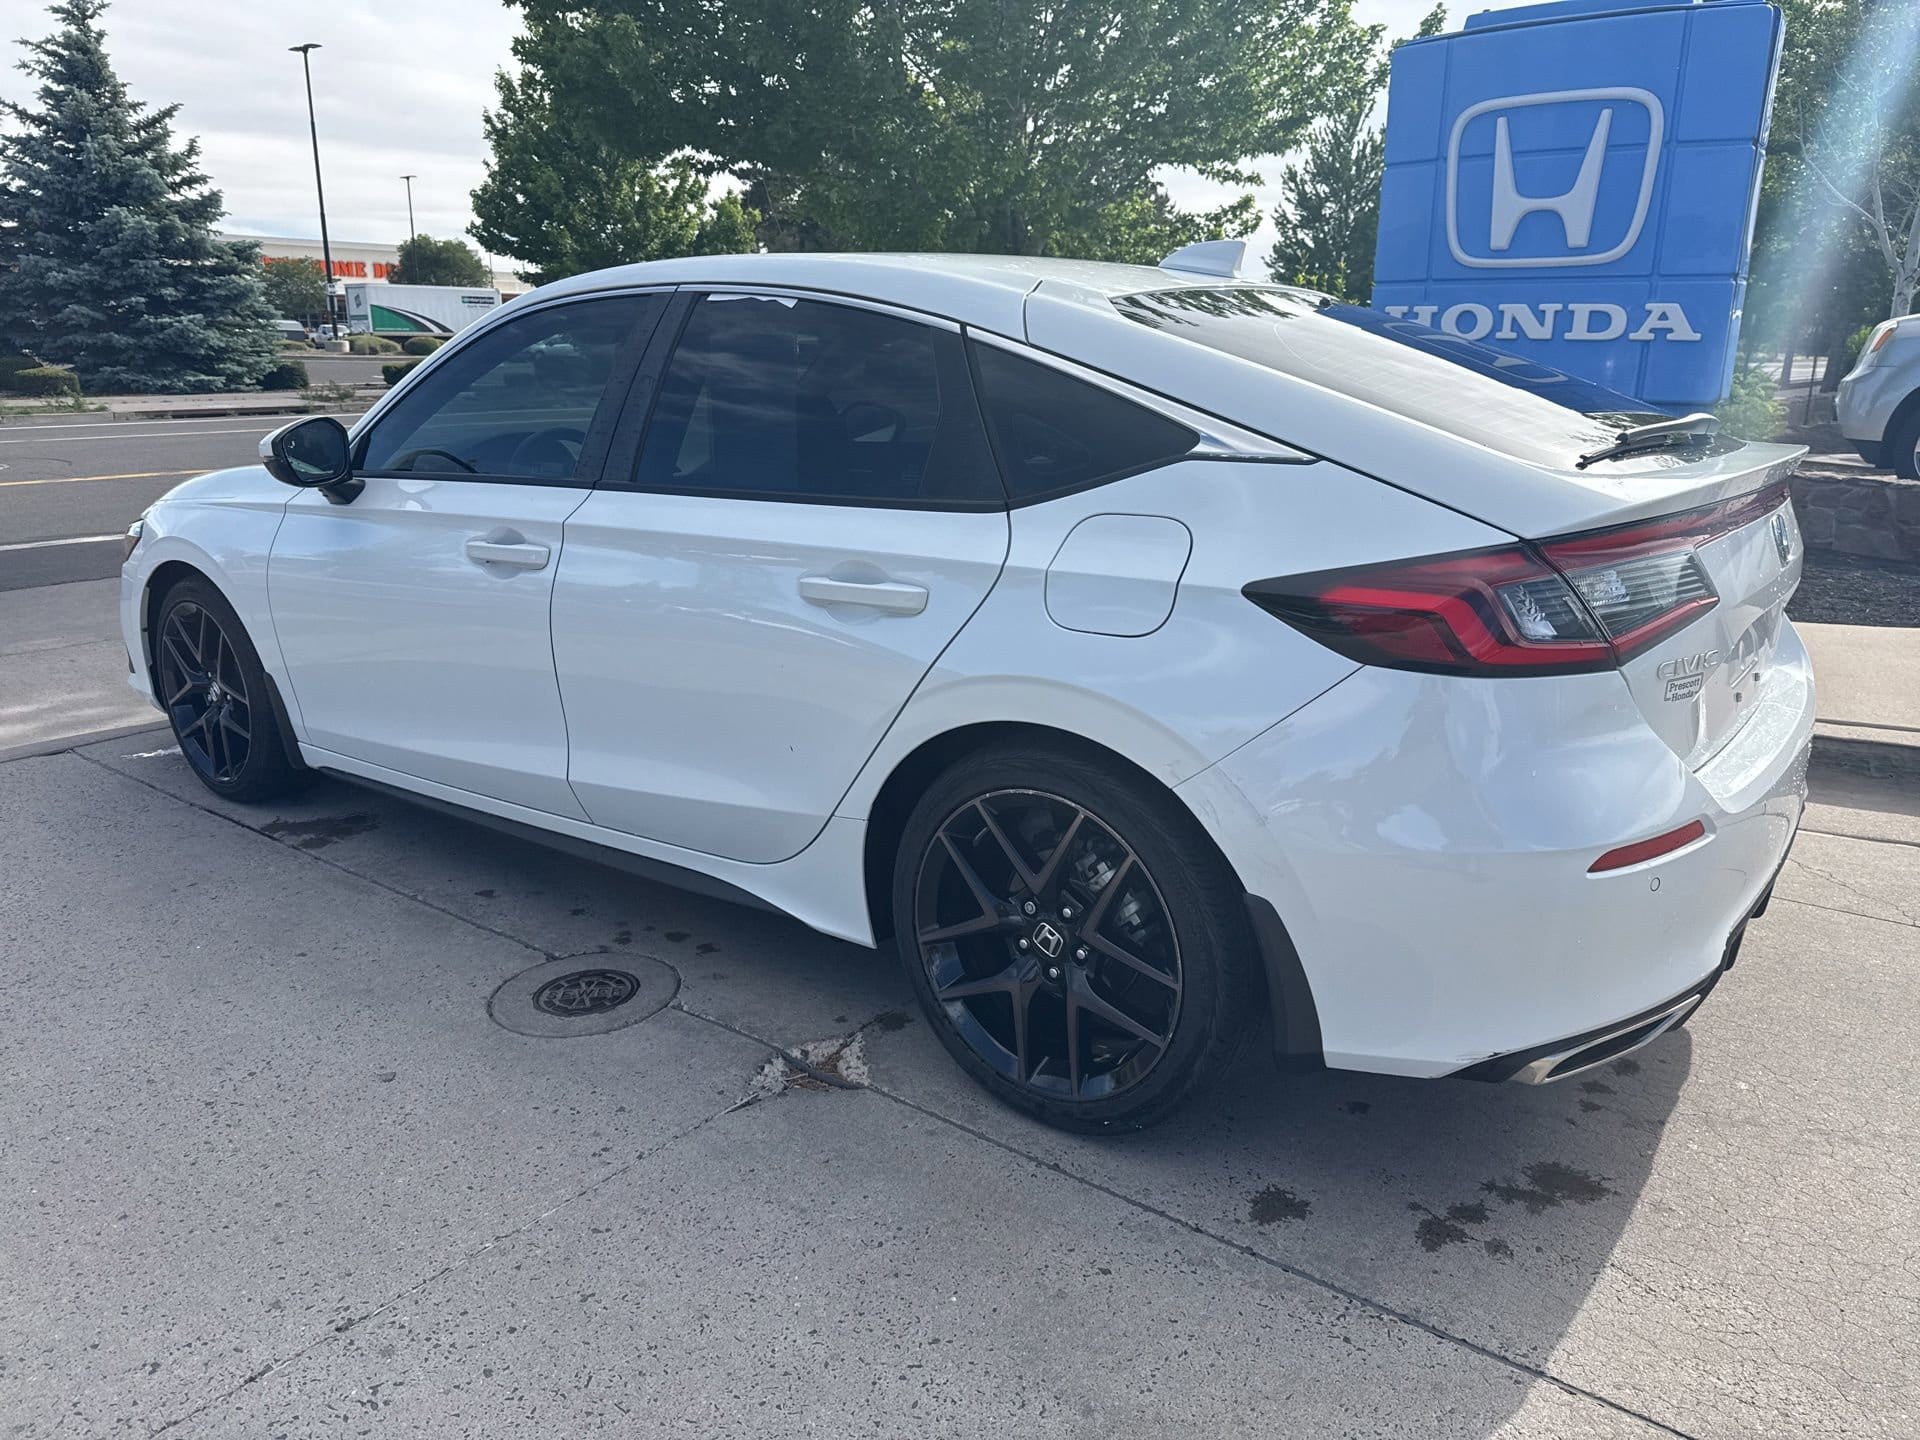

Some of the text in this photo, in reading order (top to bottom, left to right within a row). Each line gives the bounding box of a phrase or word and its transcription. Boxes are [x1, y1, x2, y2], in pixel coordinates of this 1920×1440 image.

[1657, 650, 1718, 680] CIVIC
[1668, 679, 1699, 692] Prescott
[1671, 690, 1694, 702] Honda
